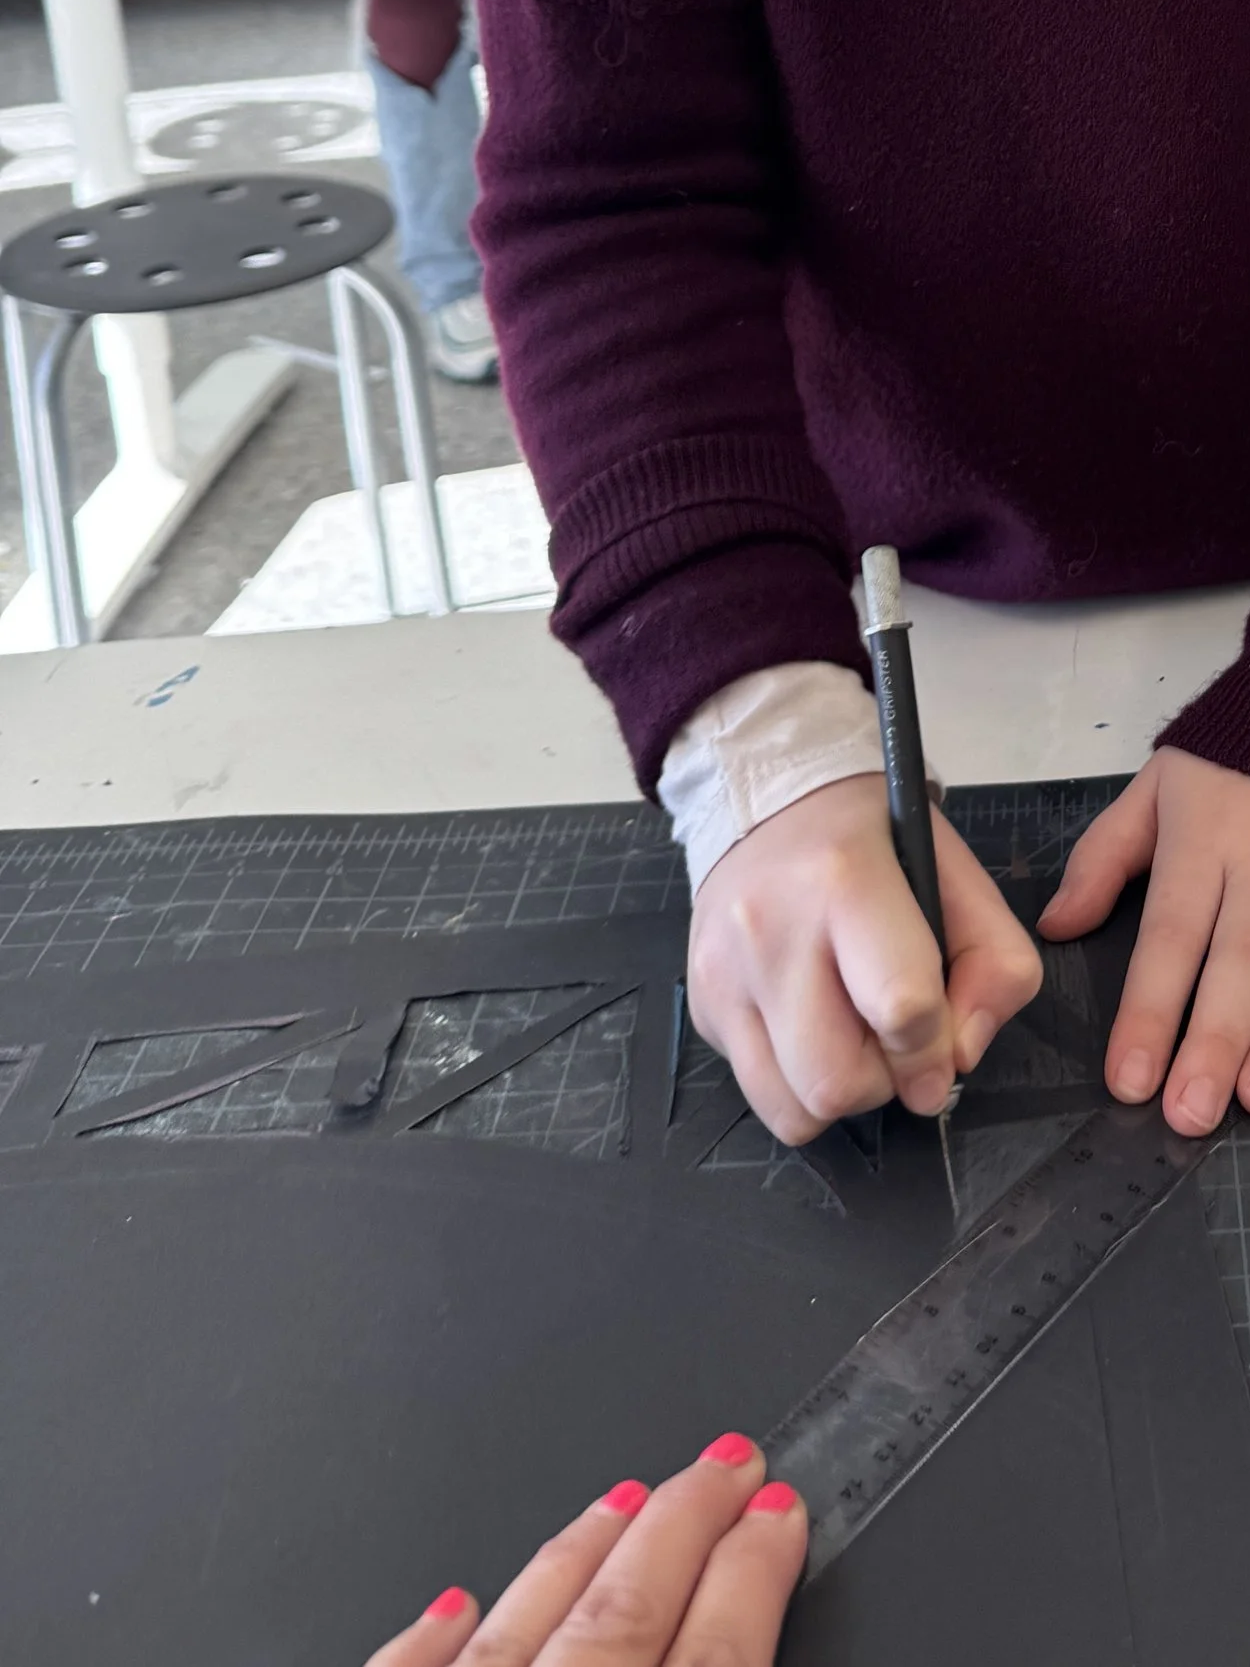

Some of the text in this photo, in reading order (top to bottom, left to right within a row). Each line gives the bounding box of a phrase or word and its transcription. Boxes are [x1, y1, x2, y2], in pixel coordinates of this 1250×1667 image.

[1127, 1183, 1142, 1195] 5
[1100, 1211, 1114, 1223] 6
[975, 1336, 998, 1354] 10
[945, 1369, 967, 1387] 11
[909, 1404, 933, 1425] 12
[873, 1440, 897, 1462] 13
[840, 1479, 863, 1499] 14
